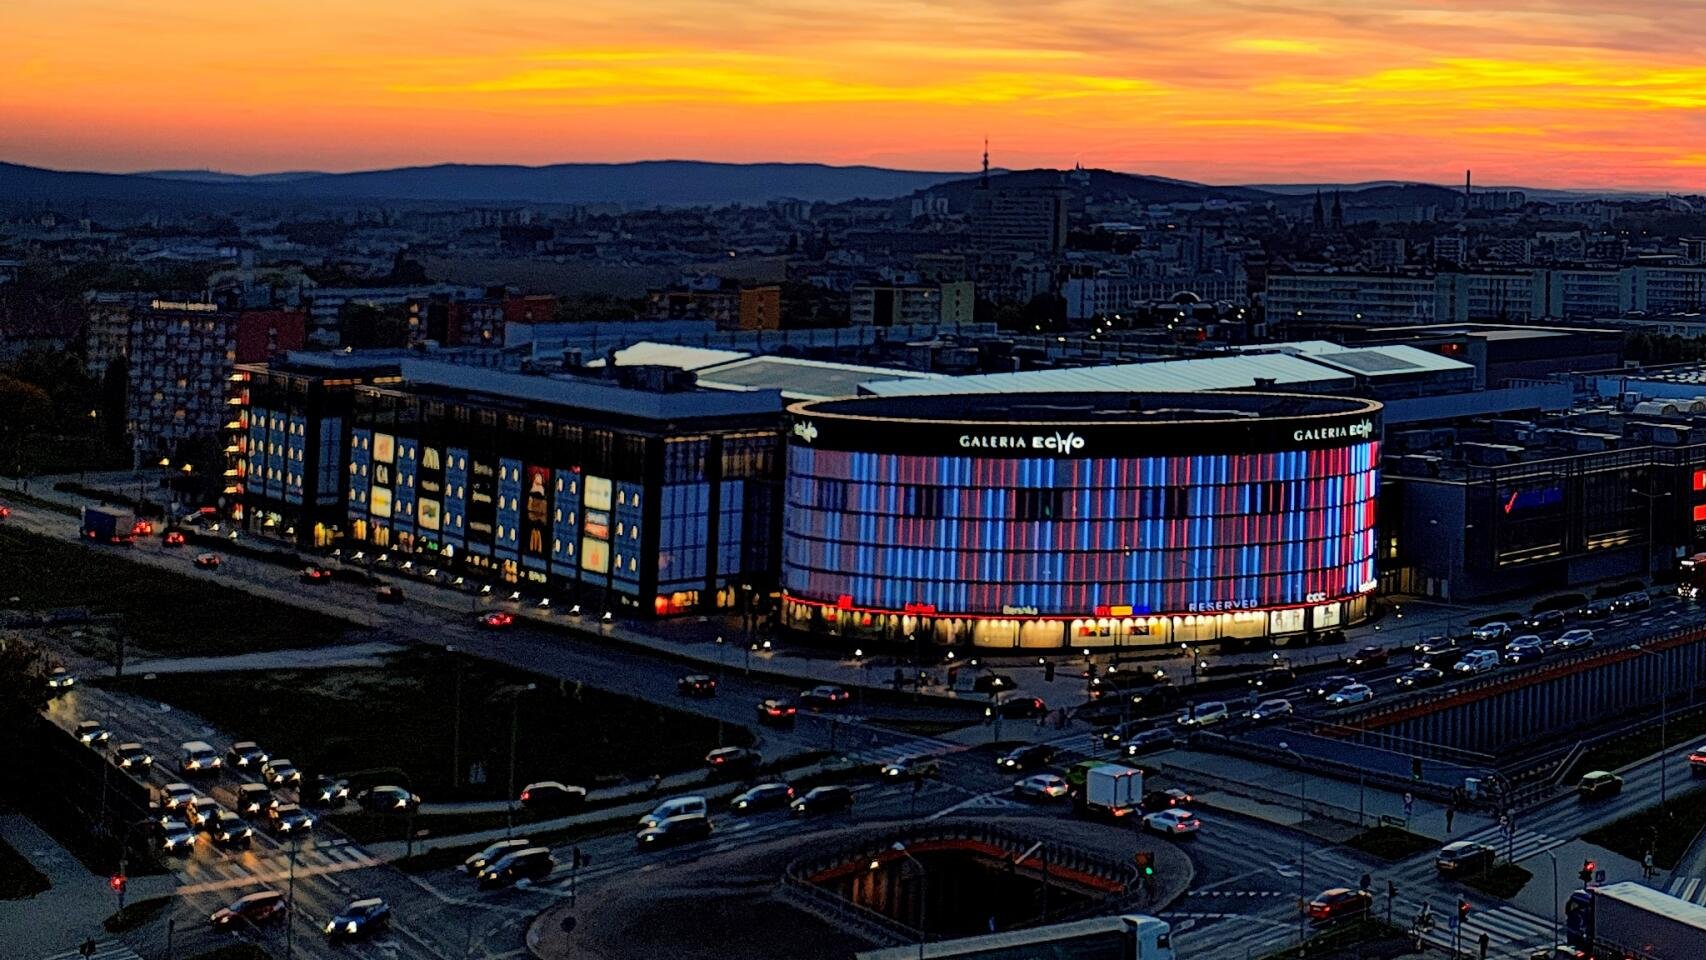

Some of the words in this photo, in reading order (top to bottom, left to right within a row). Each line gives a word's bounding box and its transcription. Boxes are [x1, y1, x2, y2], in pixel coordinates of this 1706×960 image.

[1294, 427, 1347, 441] GALERIA
[1349, 418, 1372, 439] ECHO
[960, 435, 1026, 448] GALERIA
[1032, 431, 1085, 454] ECHO
[1189, 599, 1258, 612] RESERVED
